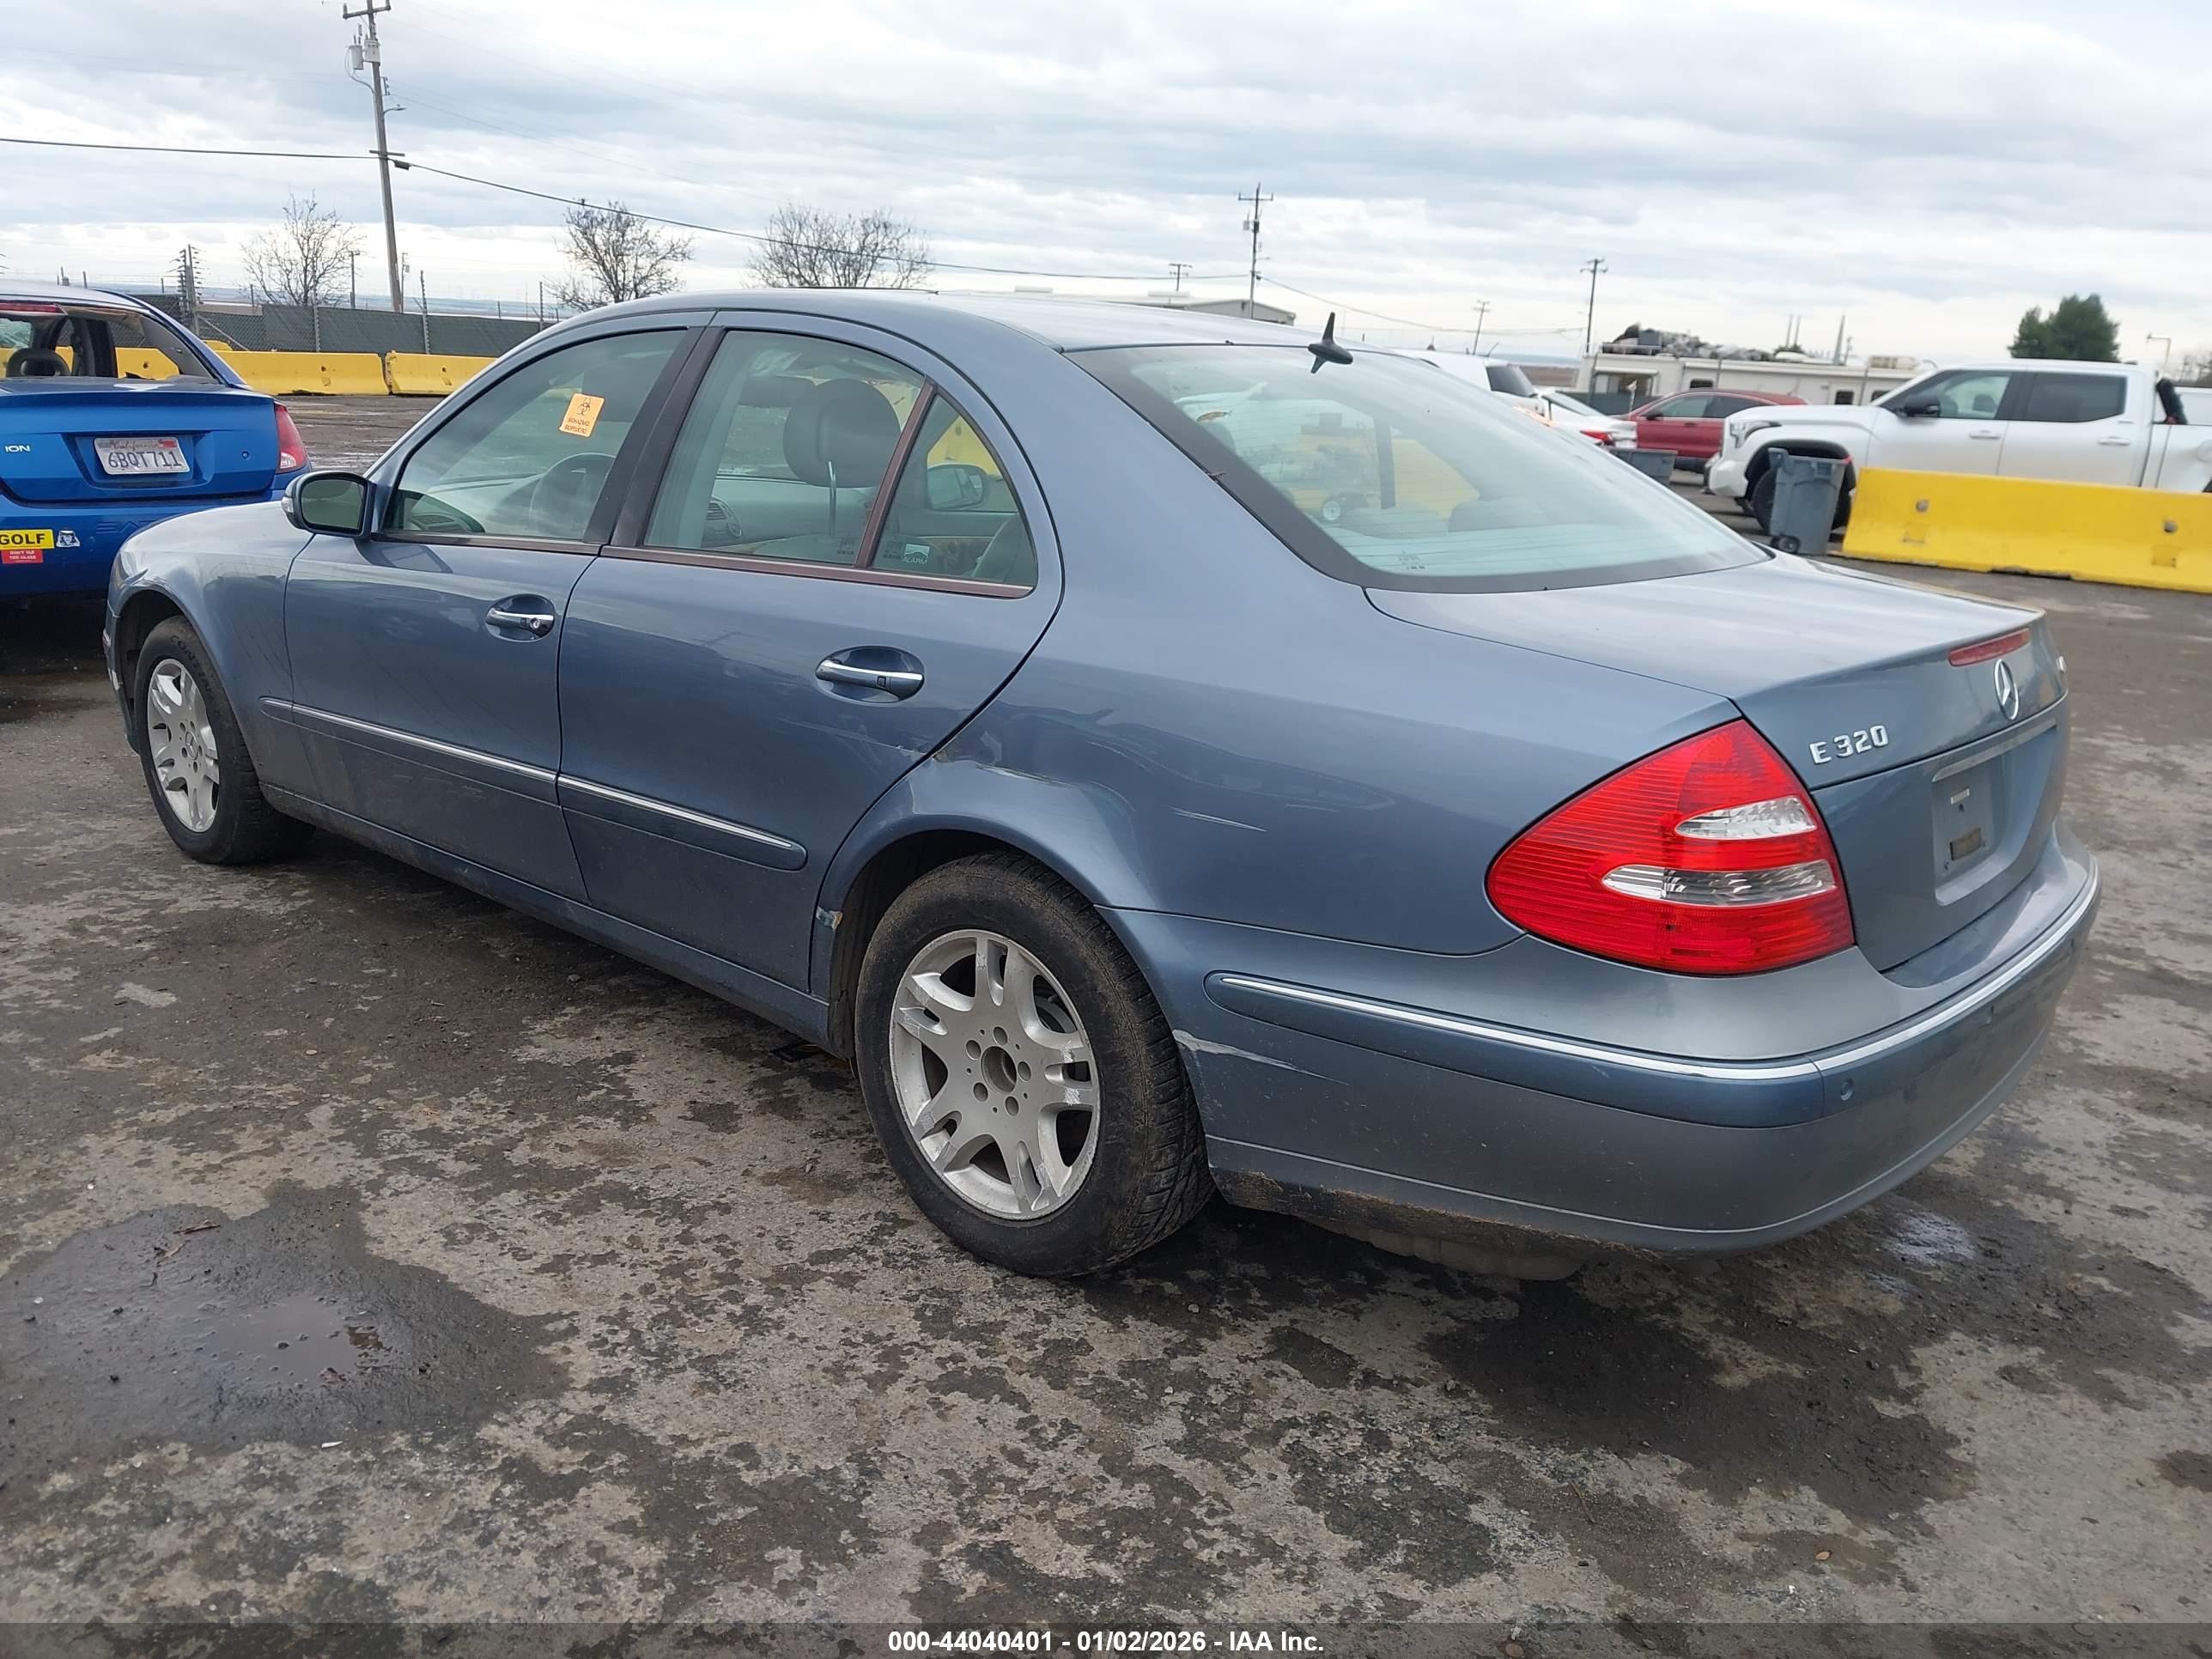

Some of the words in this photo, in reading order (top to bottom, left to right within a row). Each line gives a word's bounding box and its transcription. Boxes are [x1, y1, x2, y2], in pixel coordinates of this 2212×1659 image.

[4, 445, 31, 453] ION
[108, 451, 183, 469] 6BQT711
[0, 533, 45, 545] GOLF
[902, 556, 927, 565] ALARM
[1809, 741, 1832, 764] E
[1833, 725, 1889, 757] 320
